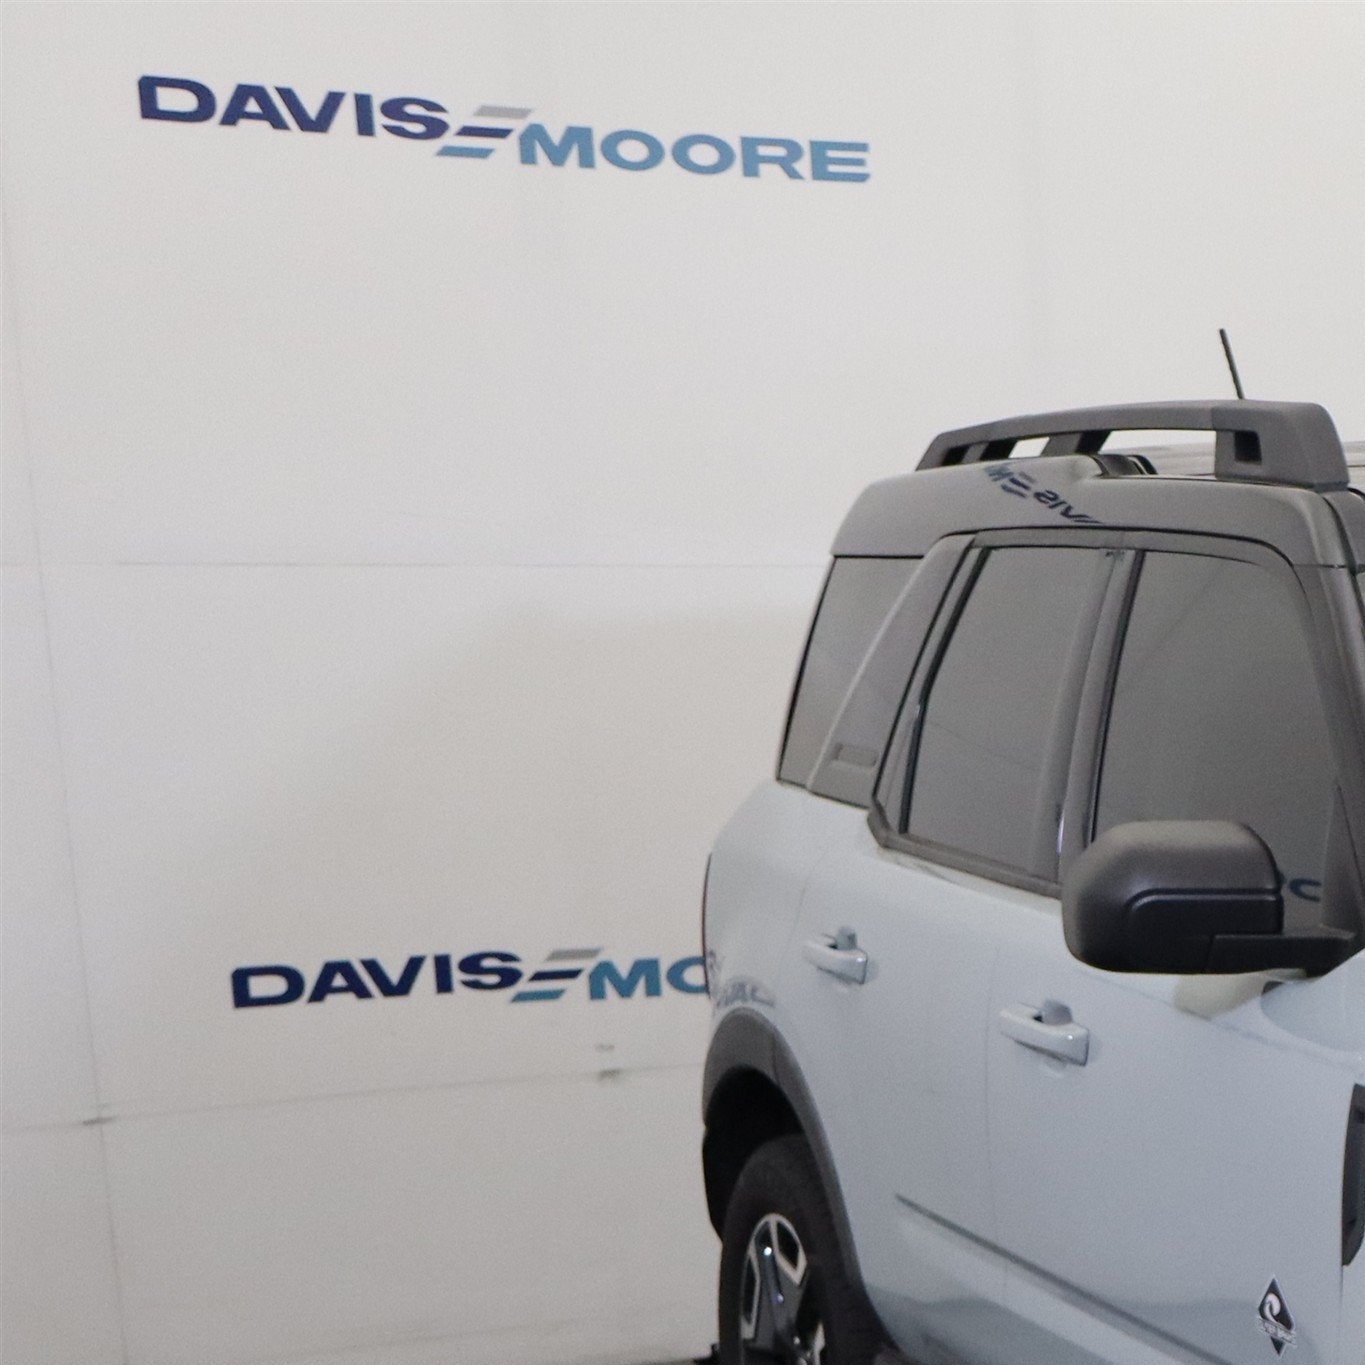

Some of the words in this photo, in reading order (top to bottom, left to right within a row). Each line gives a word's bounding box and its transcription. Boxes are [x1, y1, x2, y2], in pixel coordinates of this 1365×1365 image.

[137, 74, 450, 141] DAVIS
[518, 122, 871, 184] MOORE
[231, 950, 524, 1008] DAVIS
